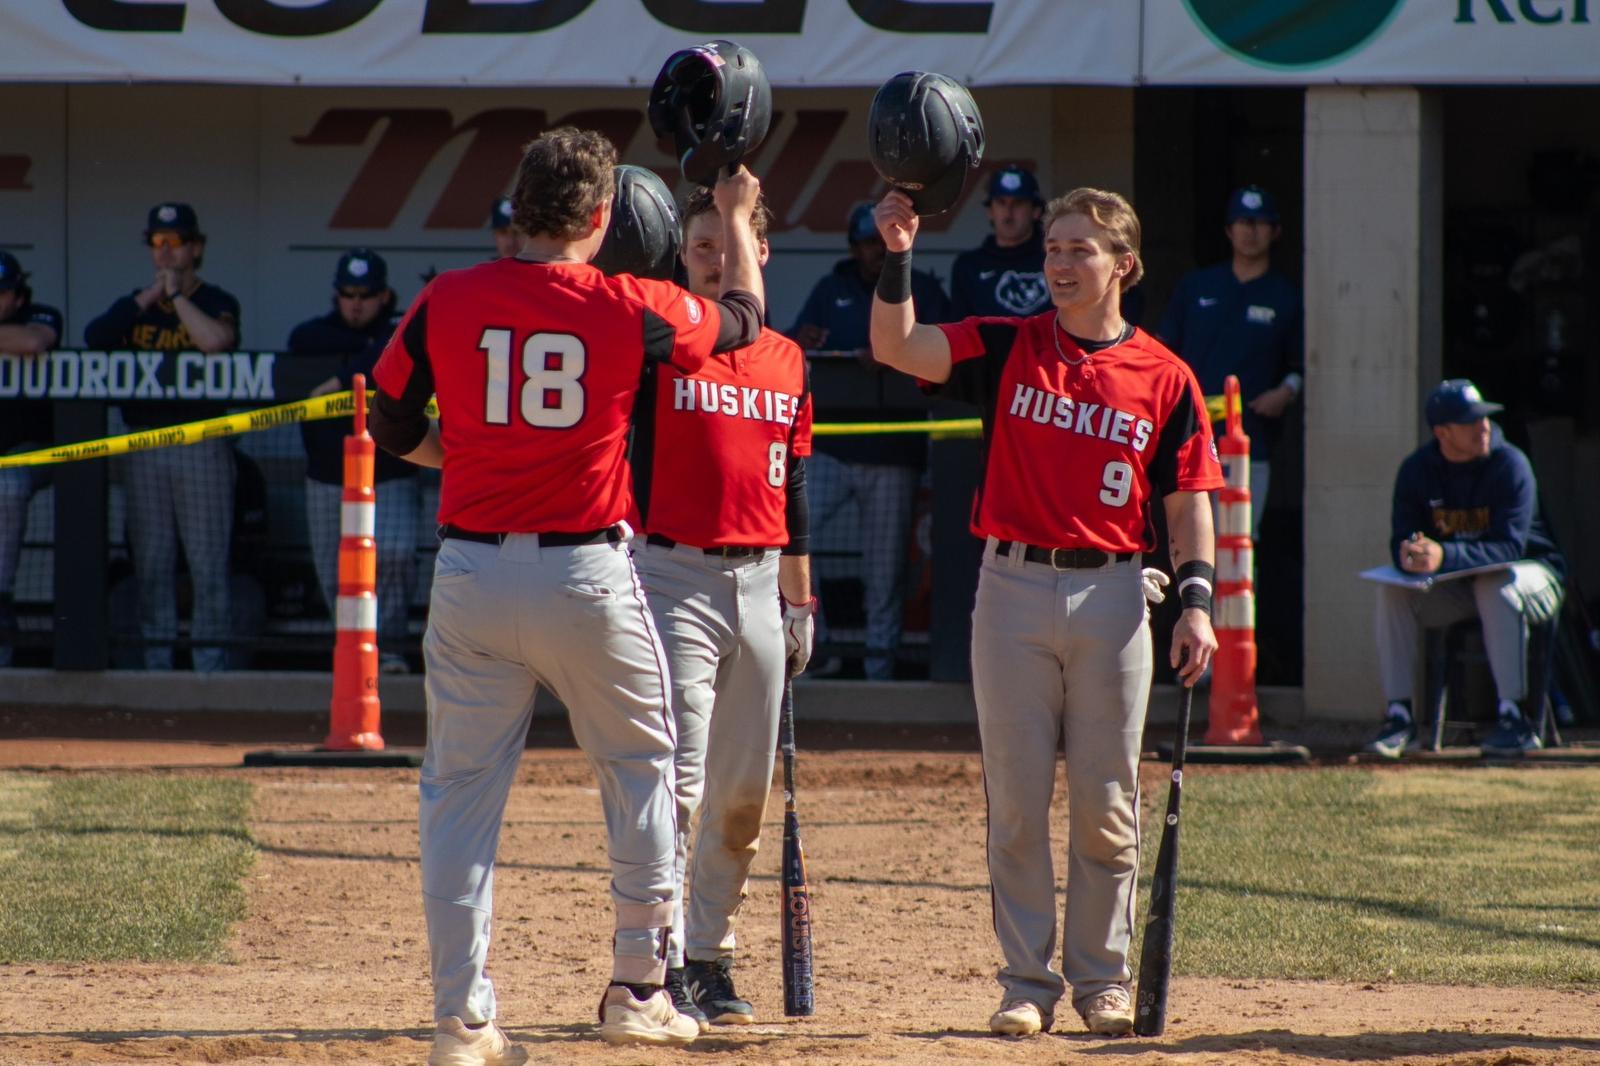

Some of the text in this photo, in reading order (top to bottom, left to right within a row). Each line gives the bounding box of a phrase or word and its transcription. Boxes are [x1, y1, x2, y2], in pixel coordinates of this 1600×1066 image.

[0, 352, 275, 399] OUDROX.COM
[477, 326, 587, 431] 18
[128, 428, 186, 450] CAUTION
[250, 404, 307, 429] CAUTION
[1009, 382, 1154, 452] HUSKIES
[767, 440, 788, 488] 8
[1098, 460, 1134, 508] 9
